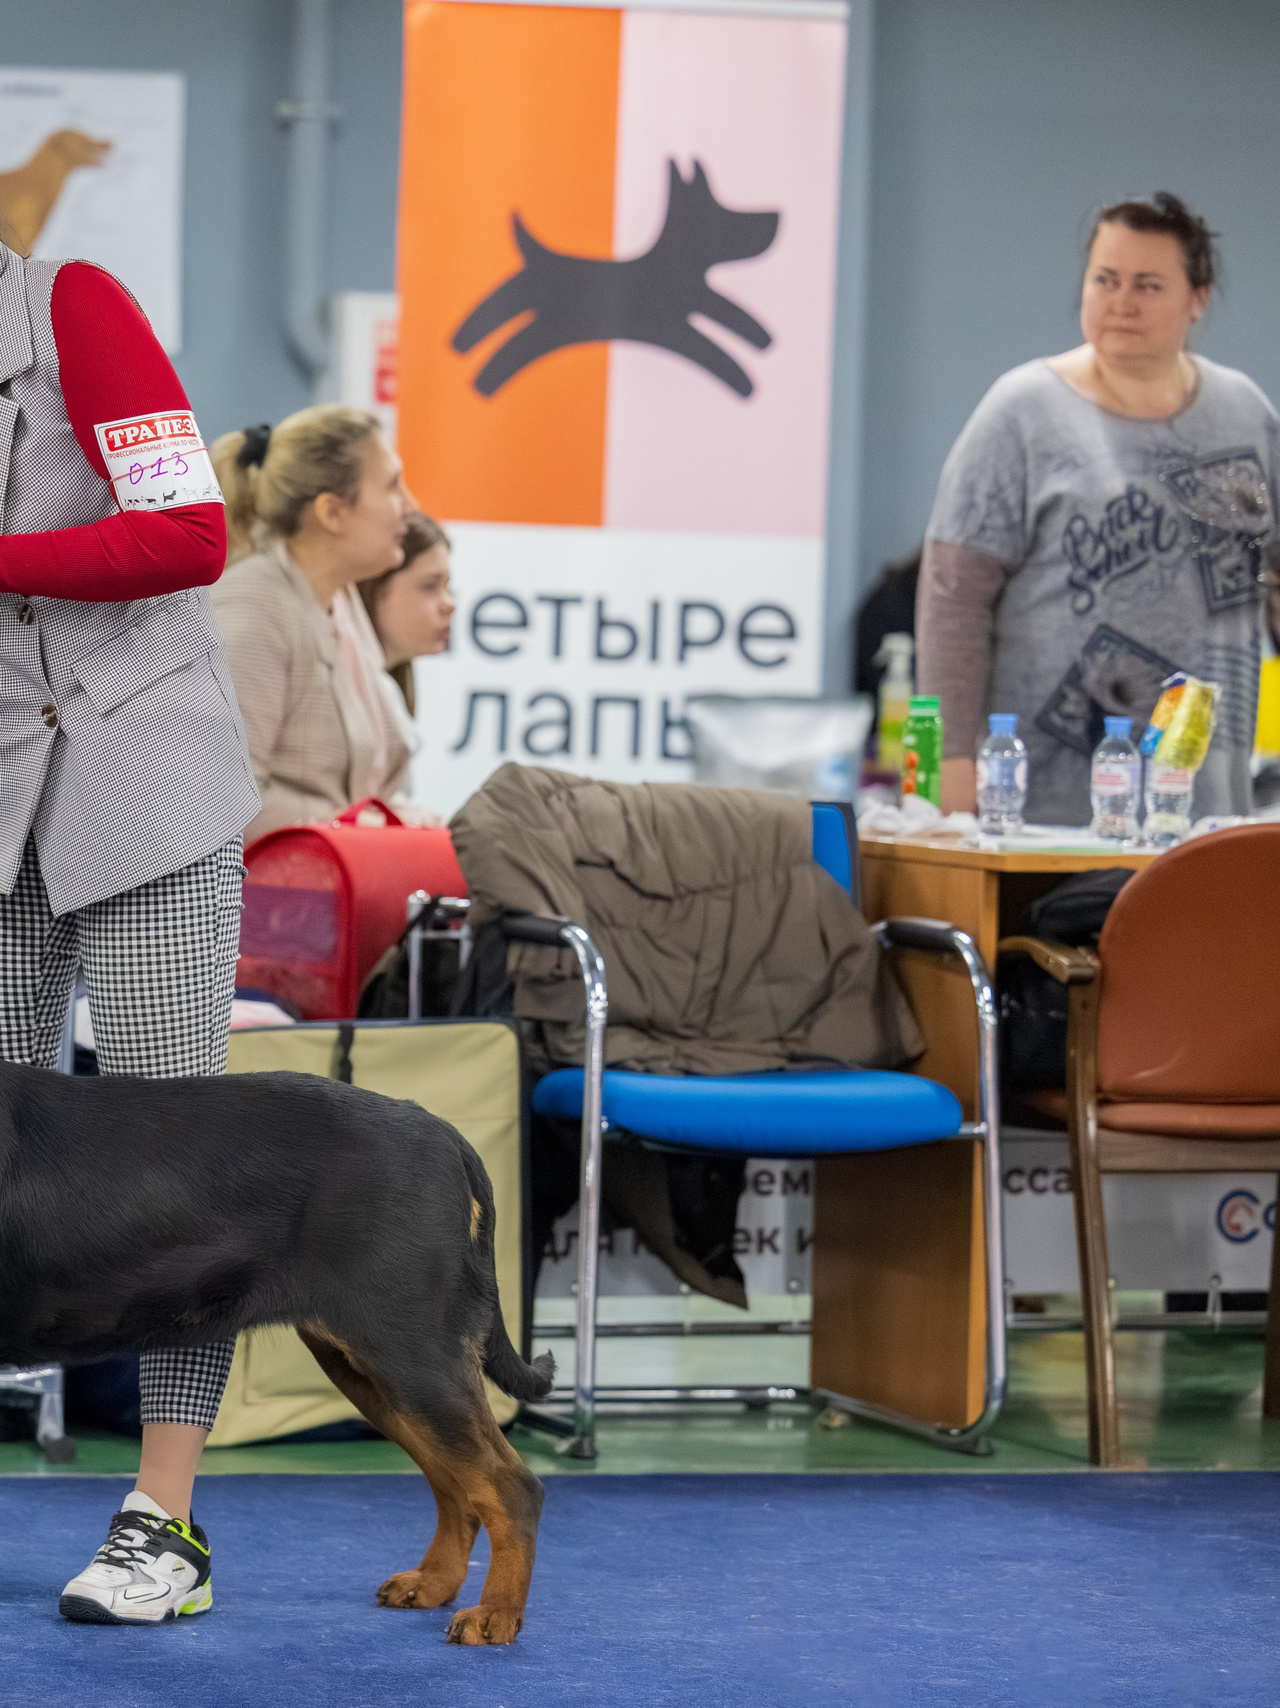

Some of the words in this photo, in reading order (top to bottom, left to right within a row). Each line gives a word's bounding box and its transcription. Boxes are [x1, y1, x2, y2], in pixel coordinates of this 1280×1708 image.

[106, 444, 162, 460] ПРОФЕССИОНАЛЬНЫЕ
[163, 439, 181, 449] КОРМА
[129, 451, 189, 485] 013
[446, 592, 798, 668] етыре
